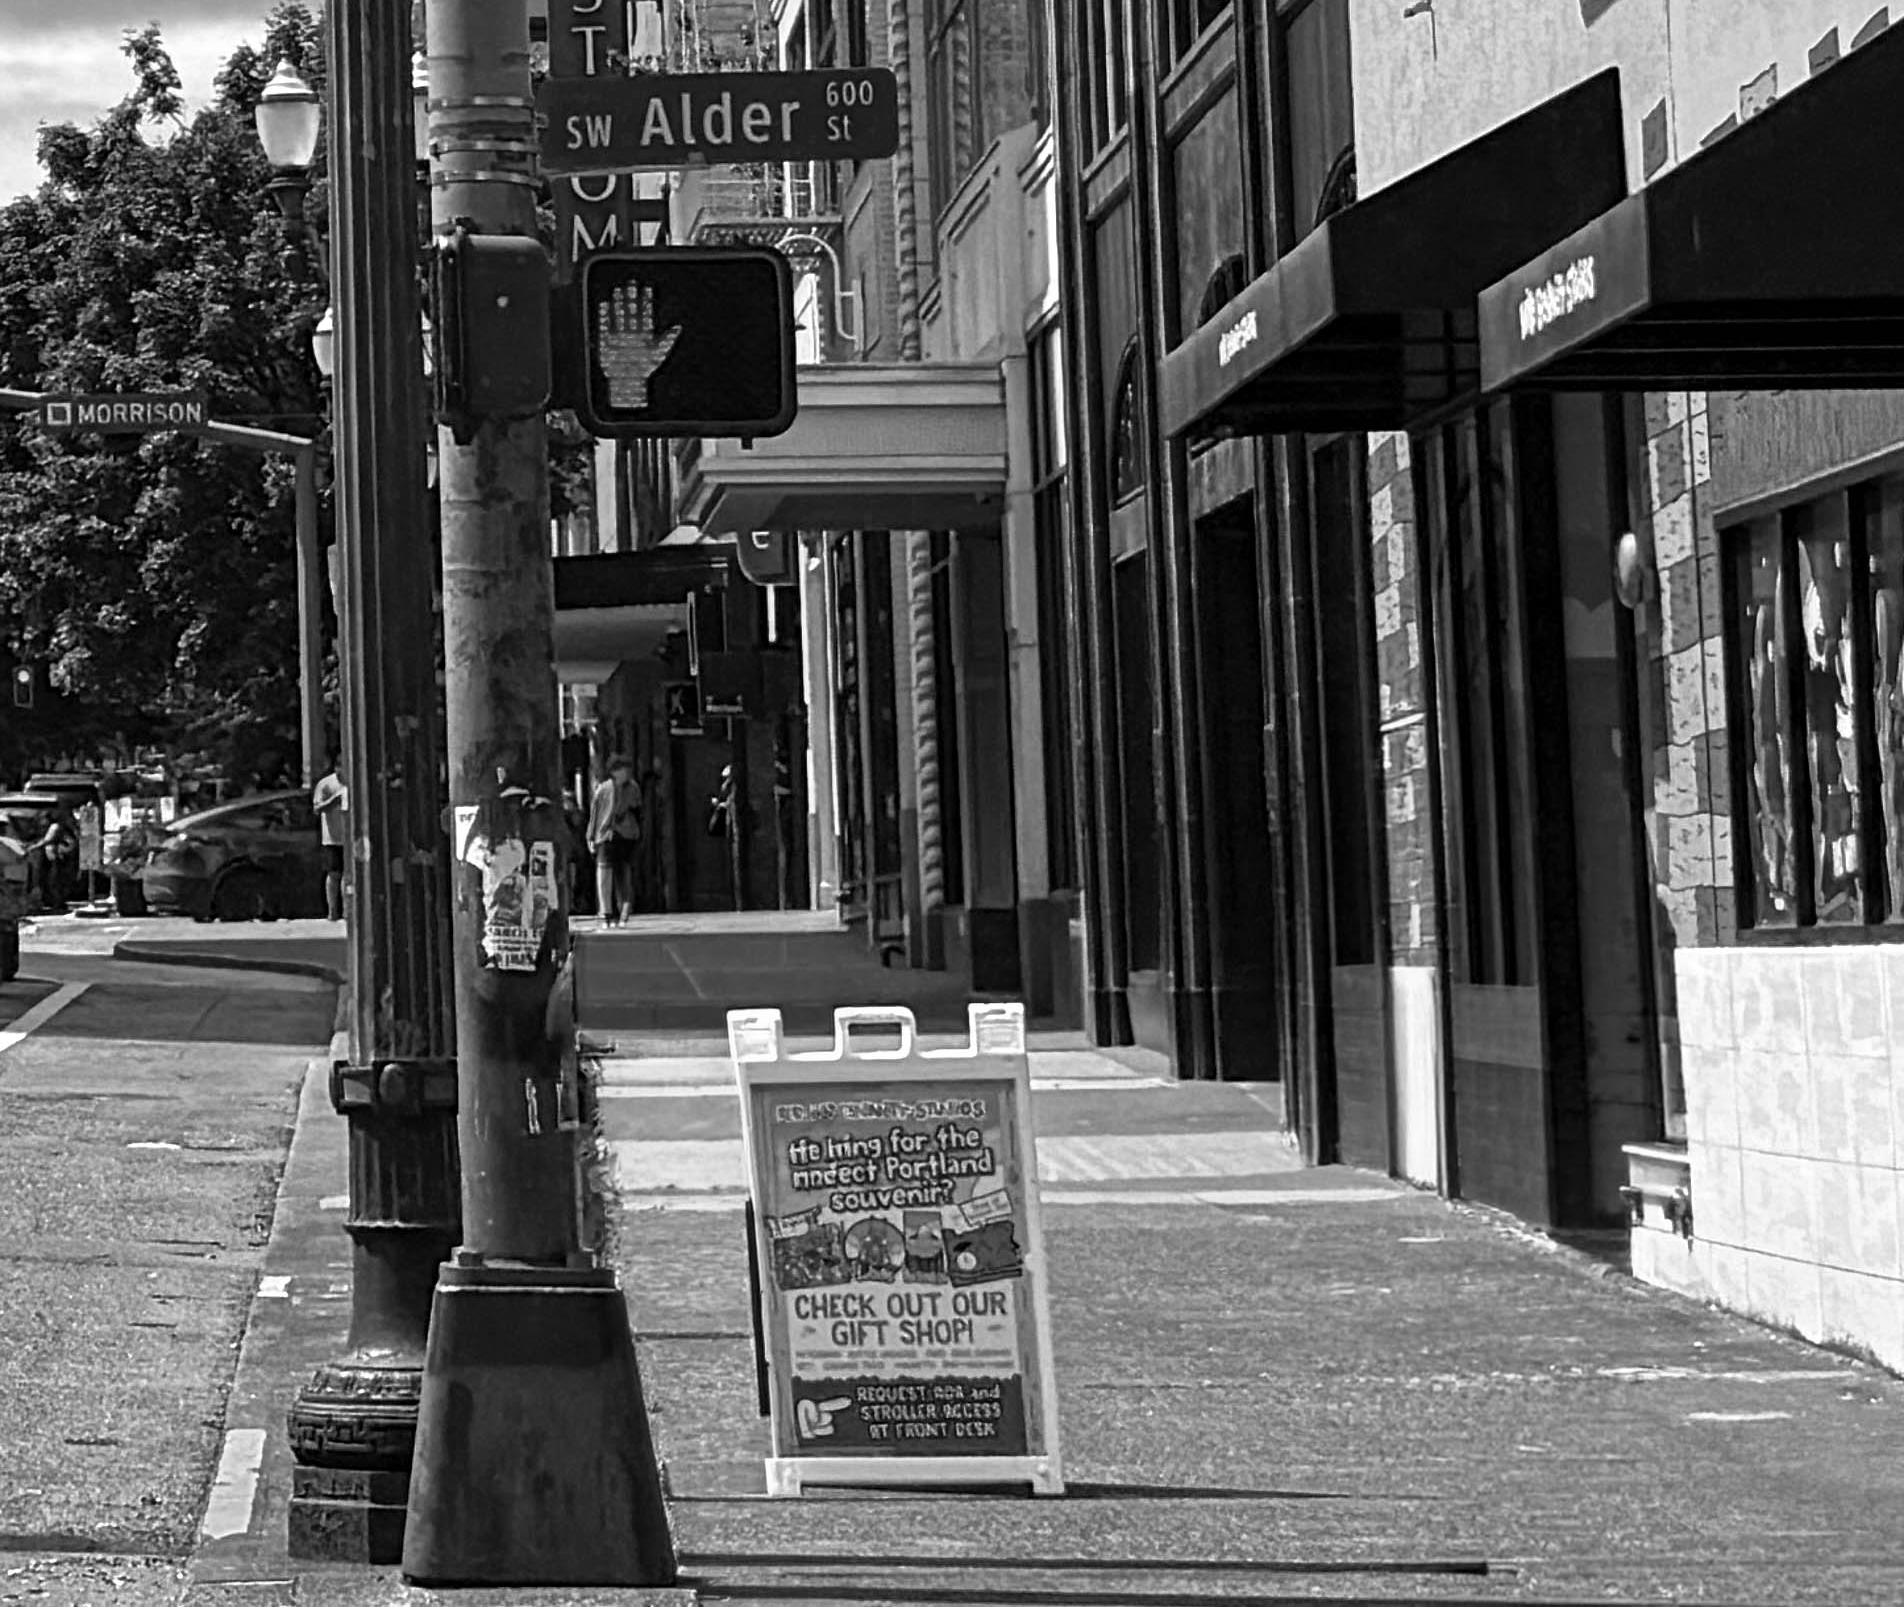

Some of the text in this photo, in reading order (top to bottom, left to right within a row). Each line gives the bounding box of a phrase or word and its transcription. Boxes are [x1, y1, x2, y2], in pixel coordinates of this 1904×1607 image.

[825, 79, 874, 108] 600
[565, 113, 613, 150] SW
[639, 91, 801, 147] Alder
[78, 401, 202, 425] MORRISON
[889, 1126, 930, 1153] for
[936, 1124, 981, 1149] the
[885, 1150, 994, 1180] Portland
[830, 1179, 955, 1212] souvenir?
[794, 1290, 1008, 1320] CHECK OUT OUR
[831, 1317, 974, 1346] GIFT SHOP!
[856, 1384, 926, 1403] REQUEST
[859, 1401, 1002, 1421] STROLLER ACCESS
[895, 1421, 947, 1439] FRONT
[954, 1421, 996, 1438] DESK
